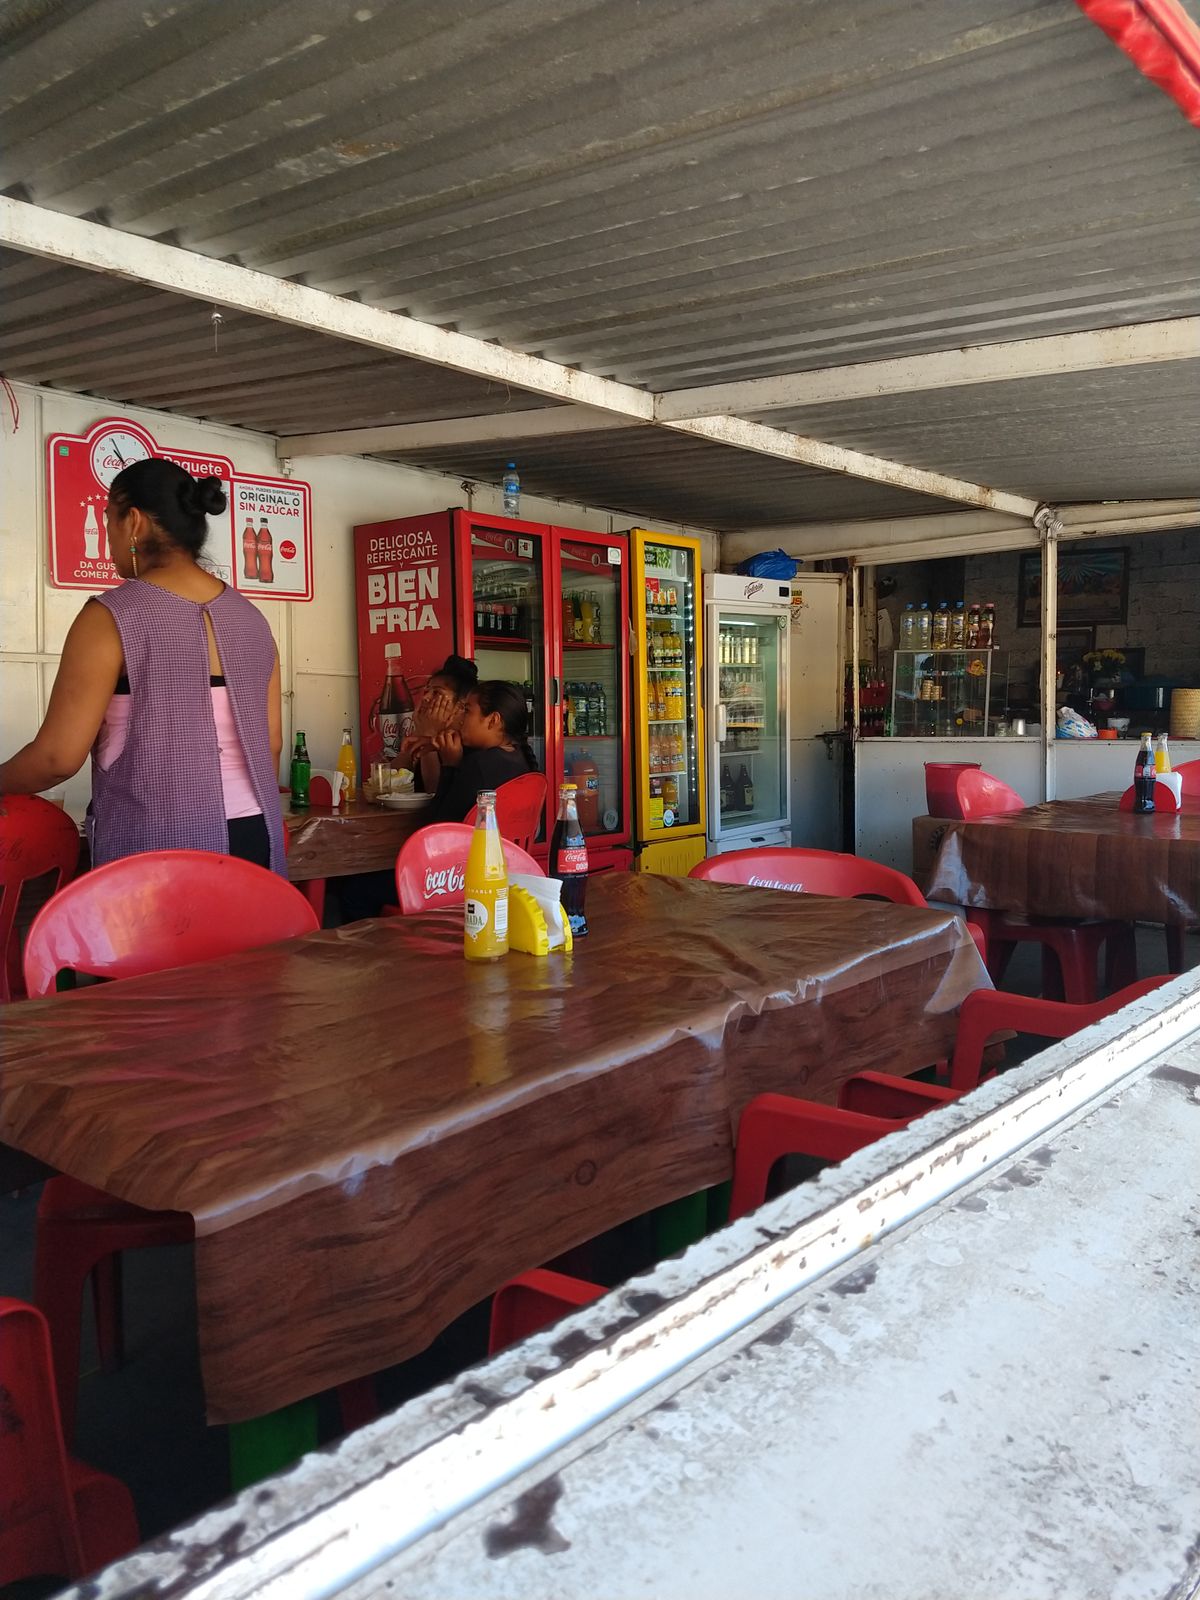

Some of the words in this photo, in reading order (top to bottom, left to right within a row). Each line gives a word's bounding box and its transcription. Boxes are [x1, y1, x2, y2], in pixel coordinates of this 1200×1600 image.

[240, 491, 290, 506] ORIGINAL
[292, 497, 300, 506] O
[239, 502, 255, 512] SIN
[259, 503, 300, 517] AZÚCAR
[370, 530, 433, 552] DELICIOSA
[367, 544, 438, 565] REFRESCANTE
[73, 569, 109, 579] COMER
[80, 560, 94, 569] DA
[96, 562, 116, 571] GUS
[367, 566, 440, 605] BIEN
[368, 603, 441, 634] FRÍA
